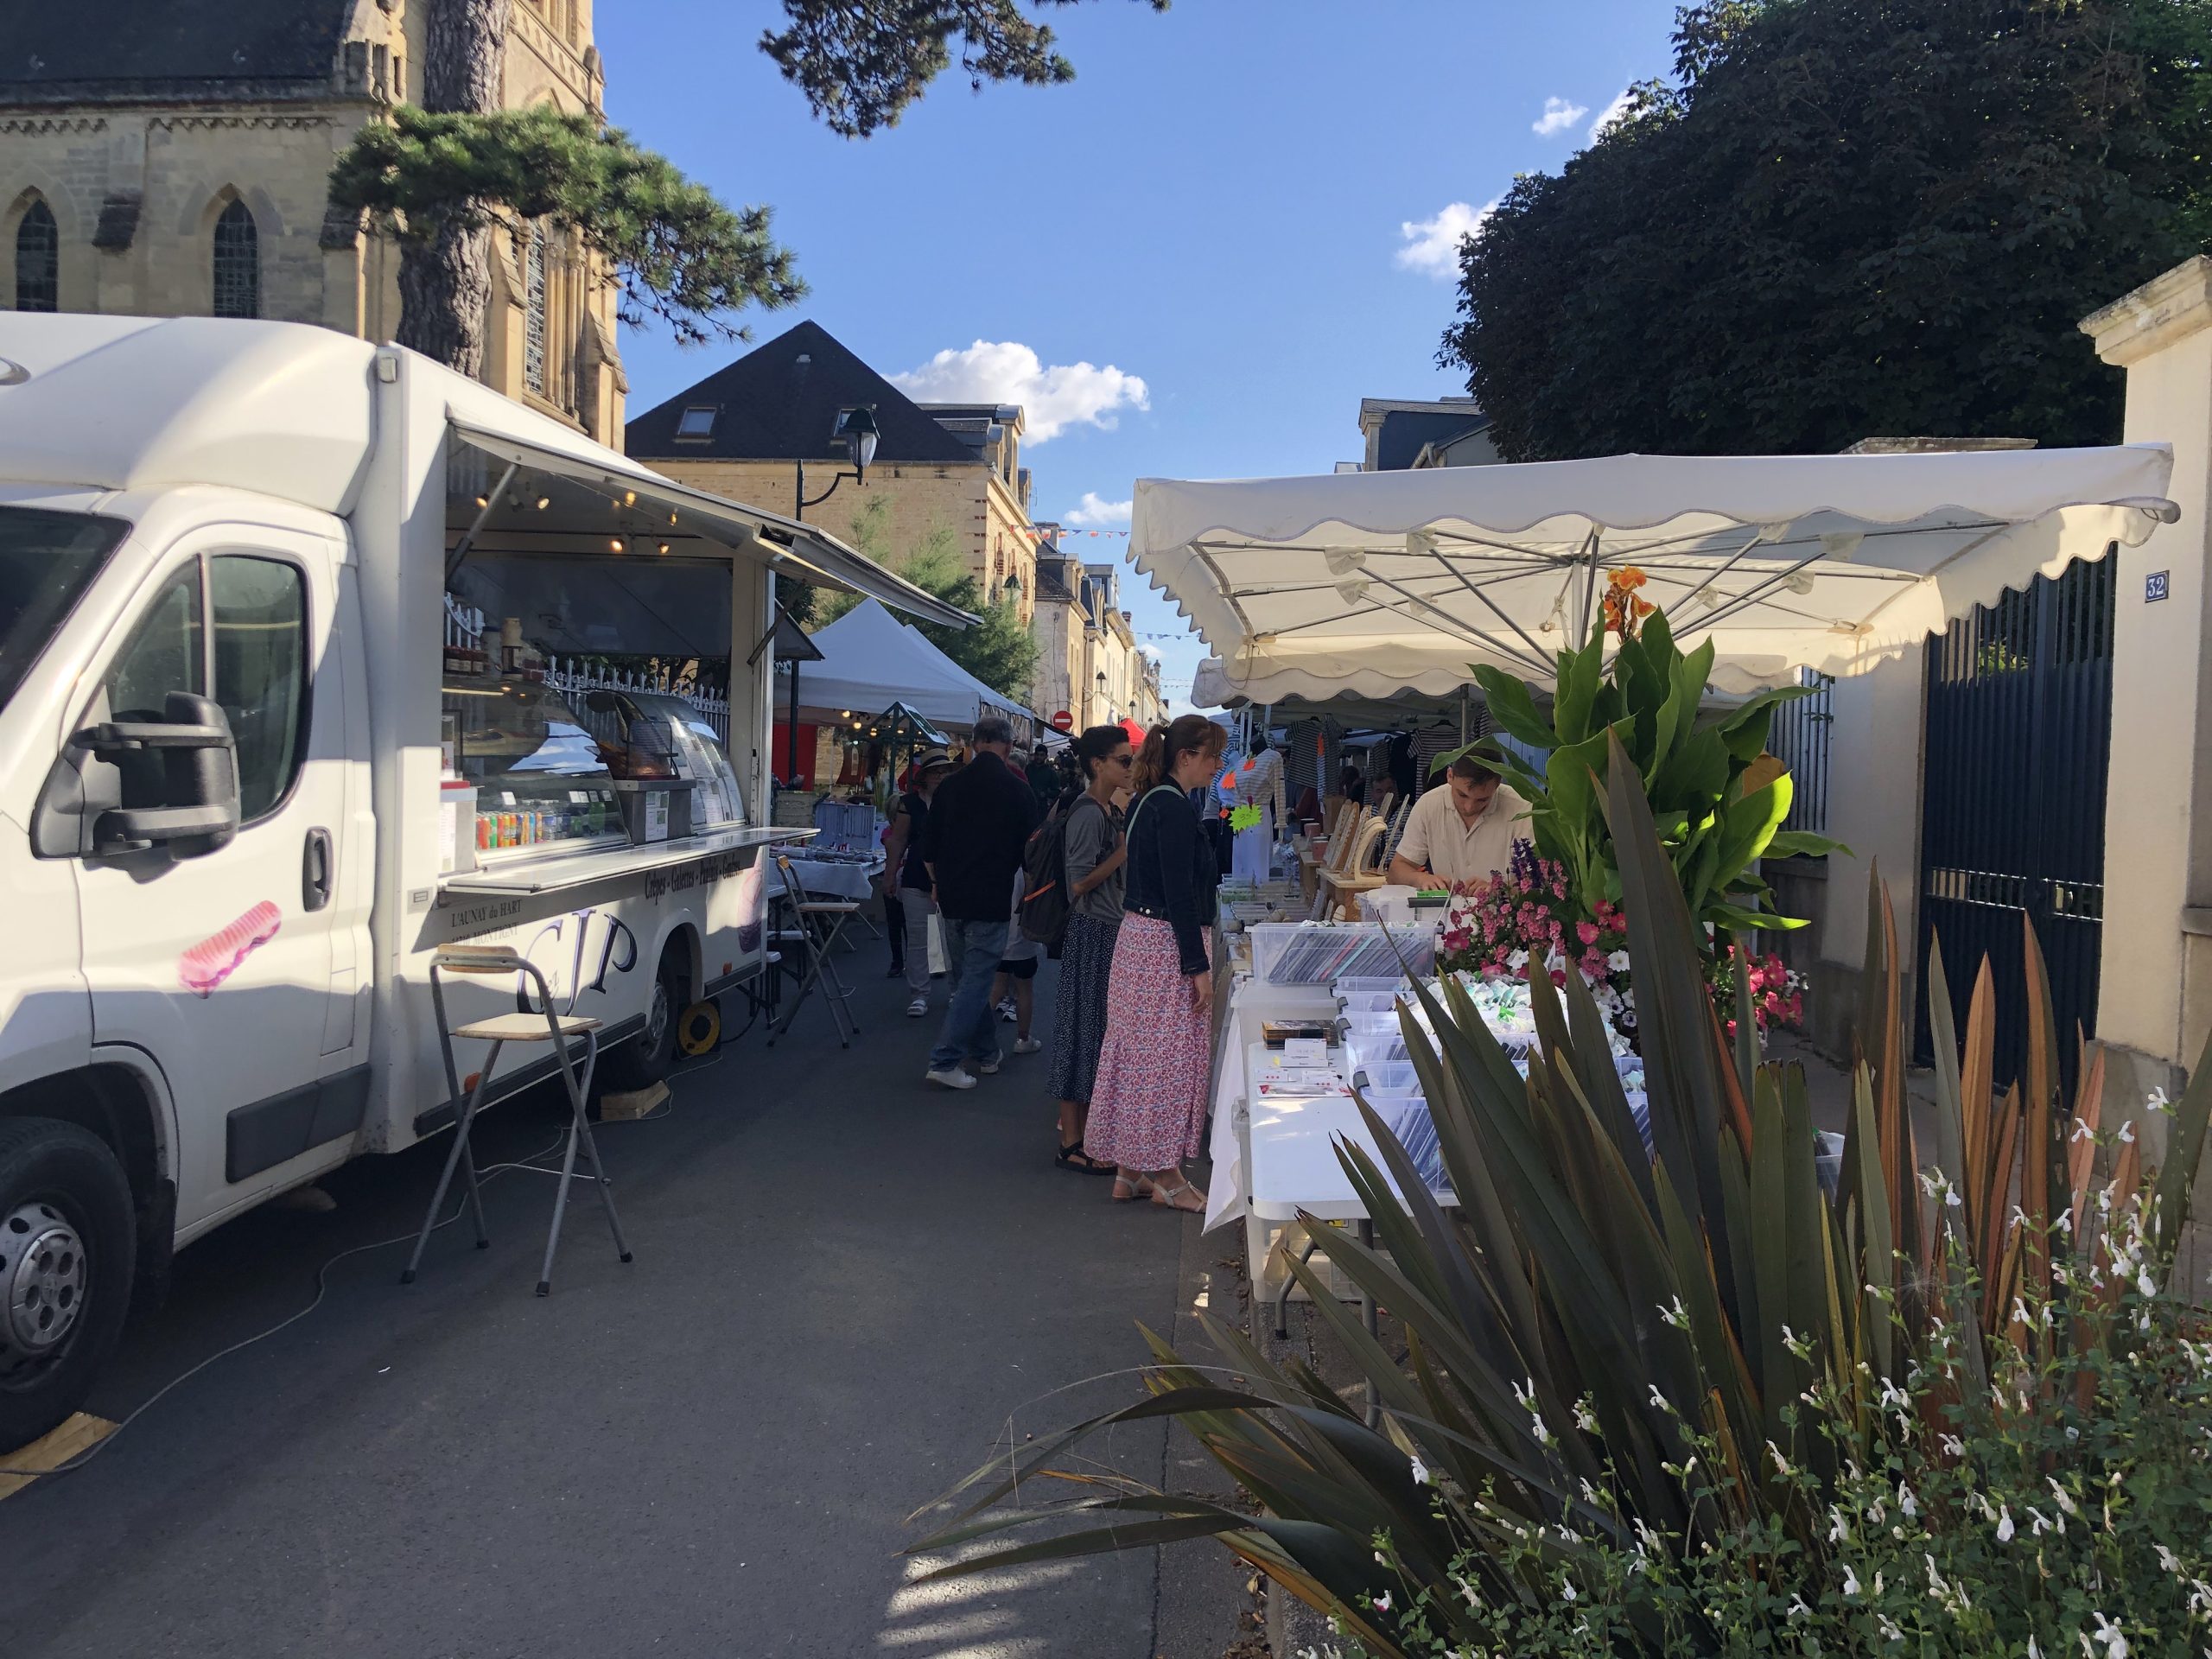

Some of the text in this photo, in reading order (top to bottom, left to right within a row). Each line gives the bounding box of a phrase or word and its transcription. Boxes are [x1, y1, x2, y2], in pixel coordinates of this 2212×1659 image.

[2147, 576, 2164, 597] 32
[645, 871, 667, 906] Crêpes
[451, 899, 523, 928] L'AUNAY du HART
